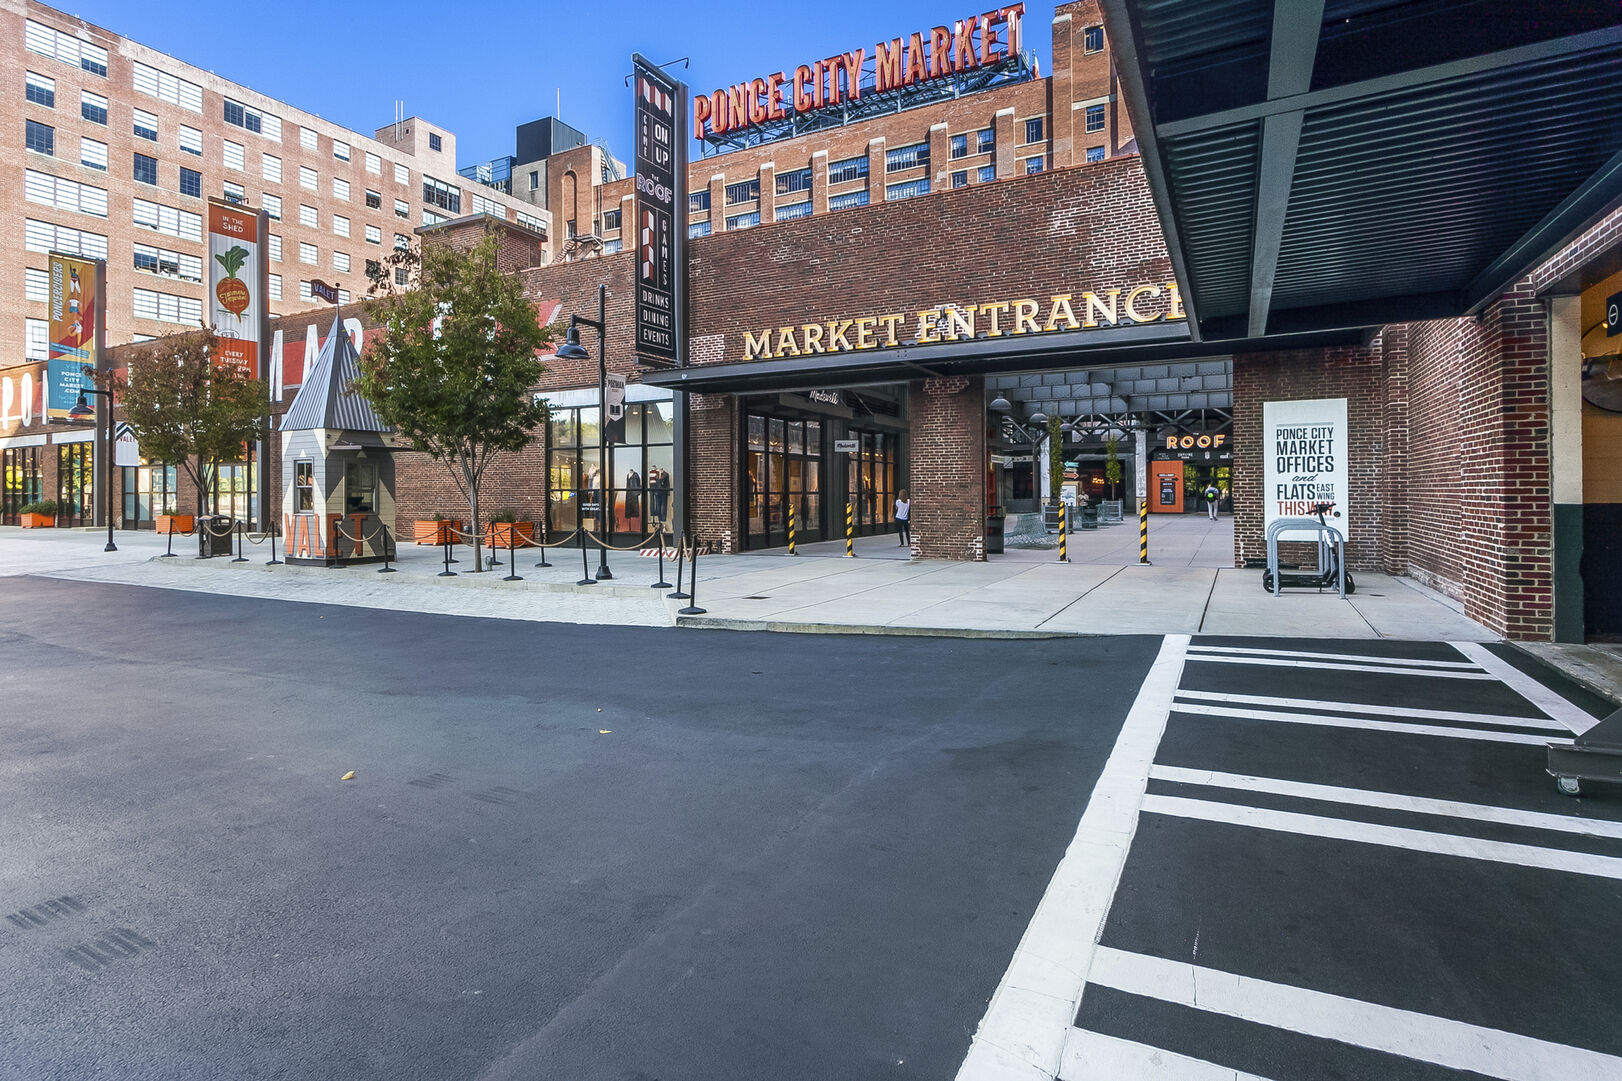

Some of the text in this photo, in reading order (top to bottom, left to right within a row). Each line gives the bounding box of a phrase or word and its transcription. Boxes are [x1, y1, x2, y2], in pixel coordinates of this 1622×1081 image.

[694, 1, 1025, 140] PONCE CITY MARKET
[654, 124, 668, 145] ON
[656, 146, 669, 166] UP
[636, 172, 673, 204] ROOF
[222, 222, 244, 233] SHED
[232, 218, 244, 226] THE
[52, 261, 64, 322] PONCERCISERS
[313, 282, 335, 300] VALET
[642, 290, 670, 309] DRINKS
[642, 309, 670, 328] DINING
[742, 282, 1186, 361] MARKET ENTRANCE
[643, 328, 670, 346] EVENTS
[220, 356, 248, 365] TUESDAY
[1166, 434, 1226, 450] ROOF
[1276, 426, 1334, 440] PONCE CITY
[1276, 440, 1334, 456] MARKET
[1276, 455, 1334, 474] OFFICES
[1292, 474, 1319, 482] and
[1277, 484, 1315, 500] FLATS
[1316, 483, 1334, 492] EAST
[1276, 501, 1305, 516] THIS
[284, 512, 367, 557] VALET
